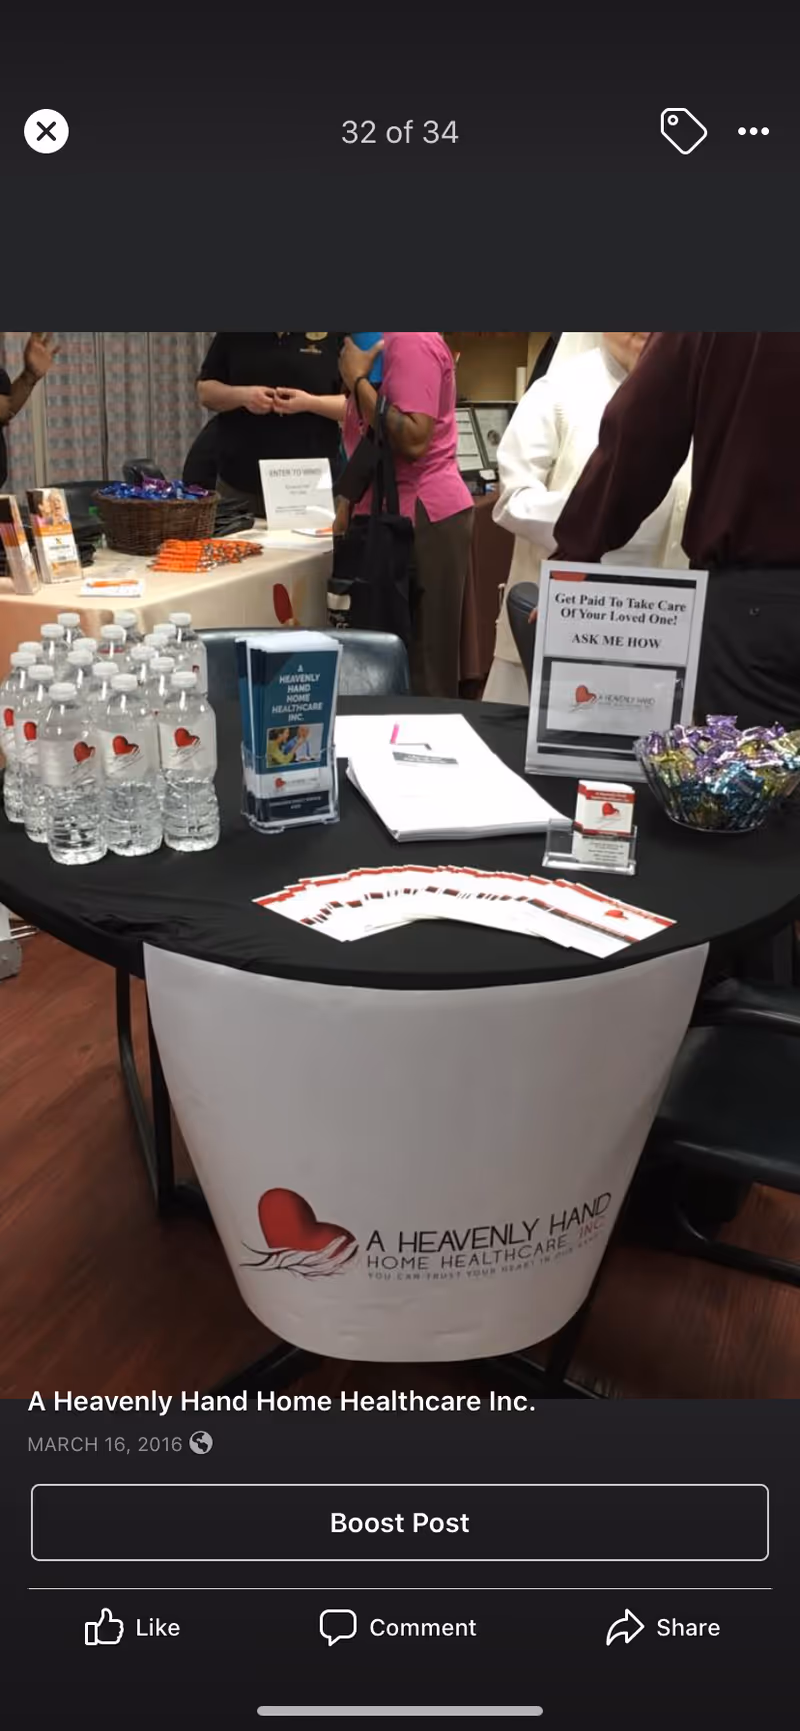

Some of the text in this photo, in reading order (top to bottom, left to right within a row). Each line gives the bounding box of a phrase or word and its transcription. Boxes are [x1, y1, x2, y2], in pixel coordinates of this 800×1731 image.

[554, 592, 687, 613] Get Paid To Take Care
[560, 607, 678, 626] Of Your Loved One!
[572, 633, 662, 649] ASK ME HOW
[297, 664, 304, 673] A
[279, 673, 321, 684] HEAVENLY
[287, 683, 312, 693] HAND
[286, 693, 311, 703] HOME
[271, 702, 323, 714] HEALTHCARE
[366, 1229, 386, 1253] A
[398, 1217, 540, 1253] HEAVENLY
[549, 1192, 612, 1236] HAND
[367, 1255, 430, 1270] HOME
[441, 1233, 568, 1269] HEALTHCARE
[368, 1272, 392, 1281] YOU
[396, 1272, 421, 1281] CAN
[427, 1271, 462, 1281] TRUST
[466, 1267, 497, 1279] YOUR
